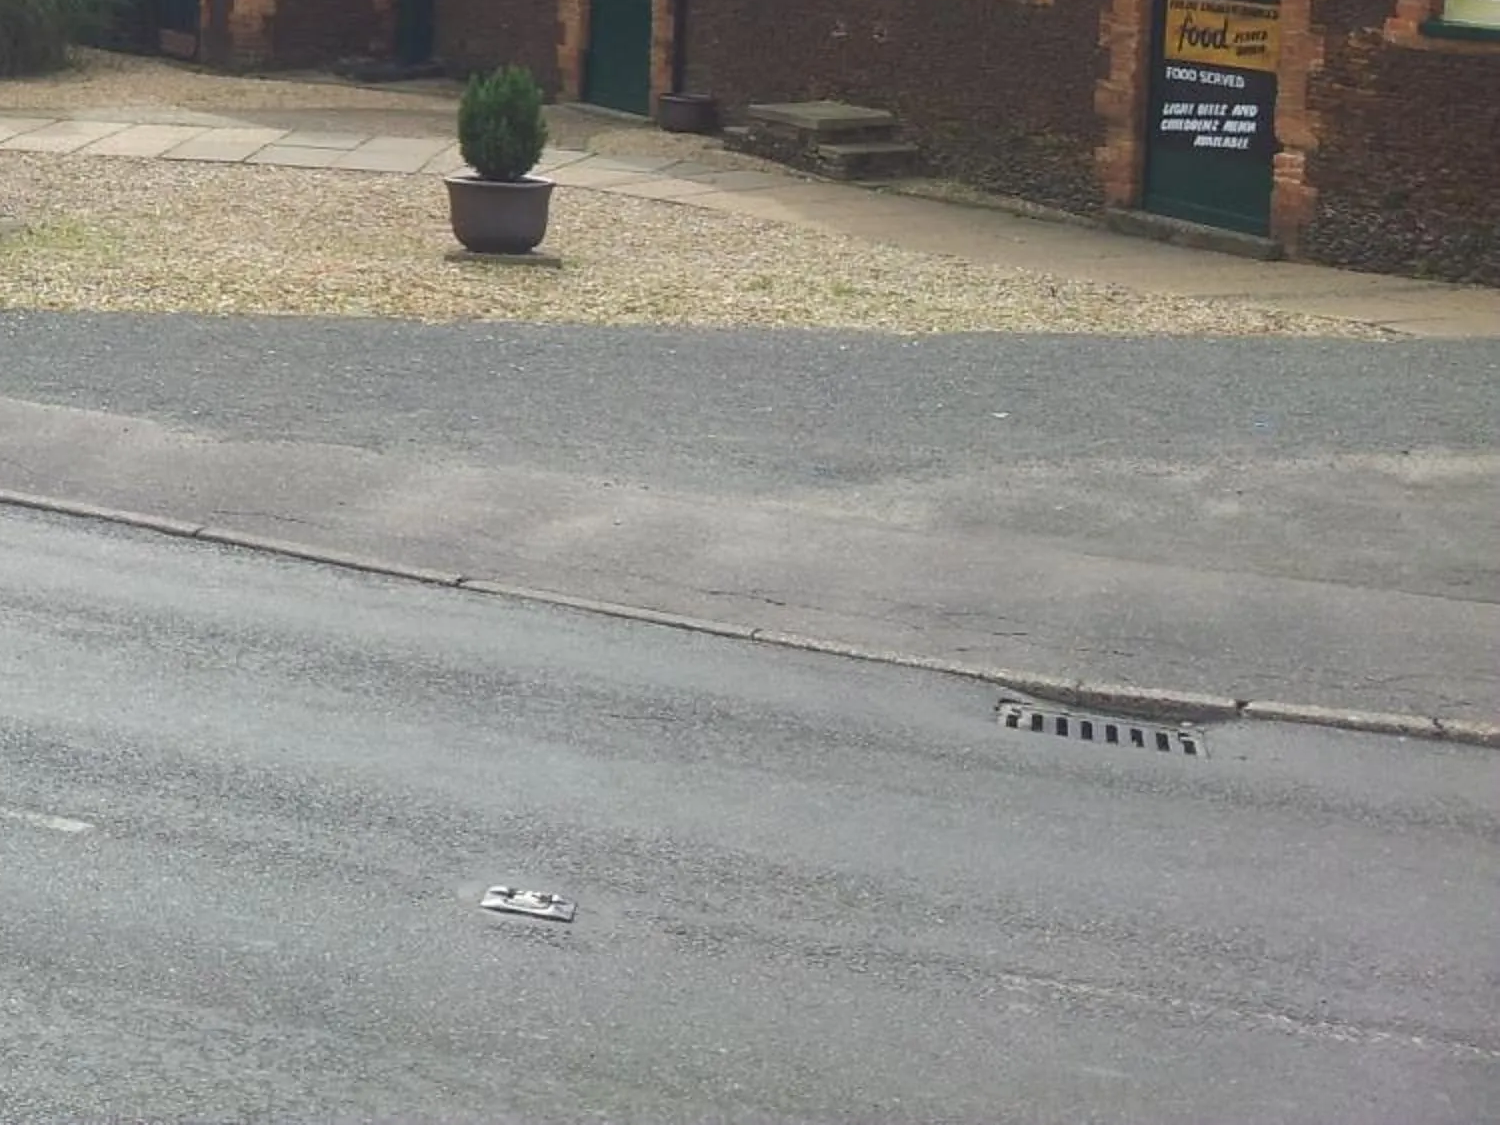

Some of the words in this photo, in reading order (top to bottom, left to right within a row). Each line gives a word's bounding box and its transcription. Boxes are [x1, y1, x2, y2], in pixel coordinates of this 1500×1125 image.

[1177, 10, 1230, 53] food
[1165, 66, 1197, 82] FOOD
[1199, 71, 1245, 88] SERVED
